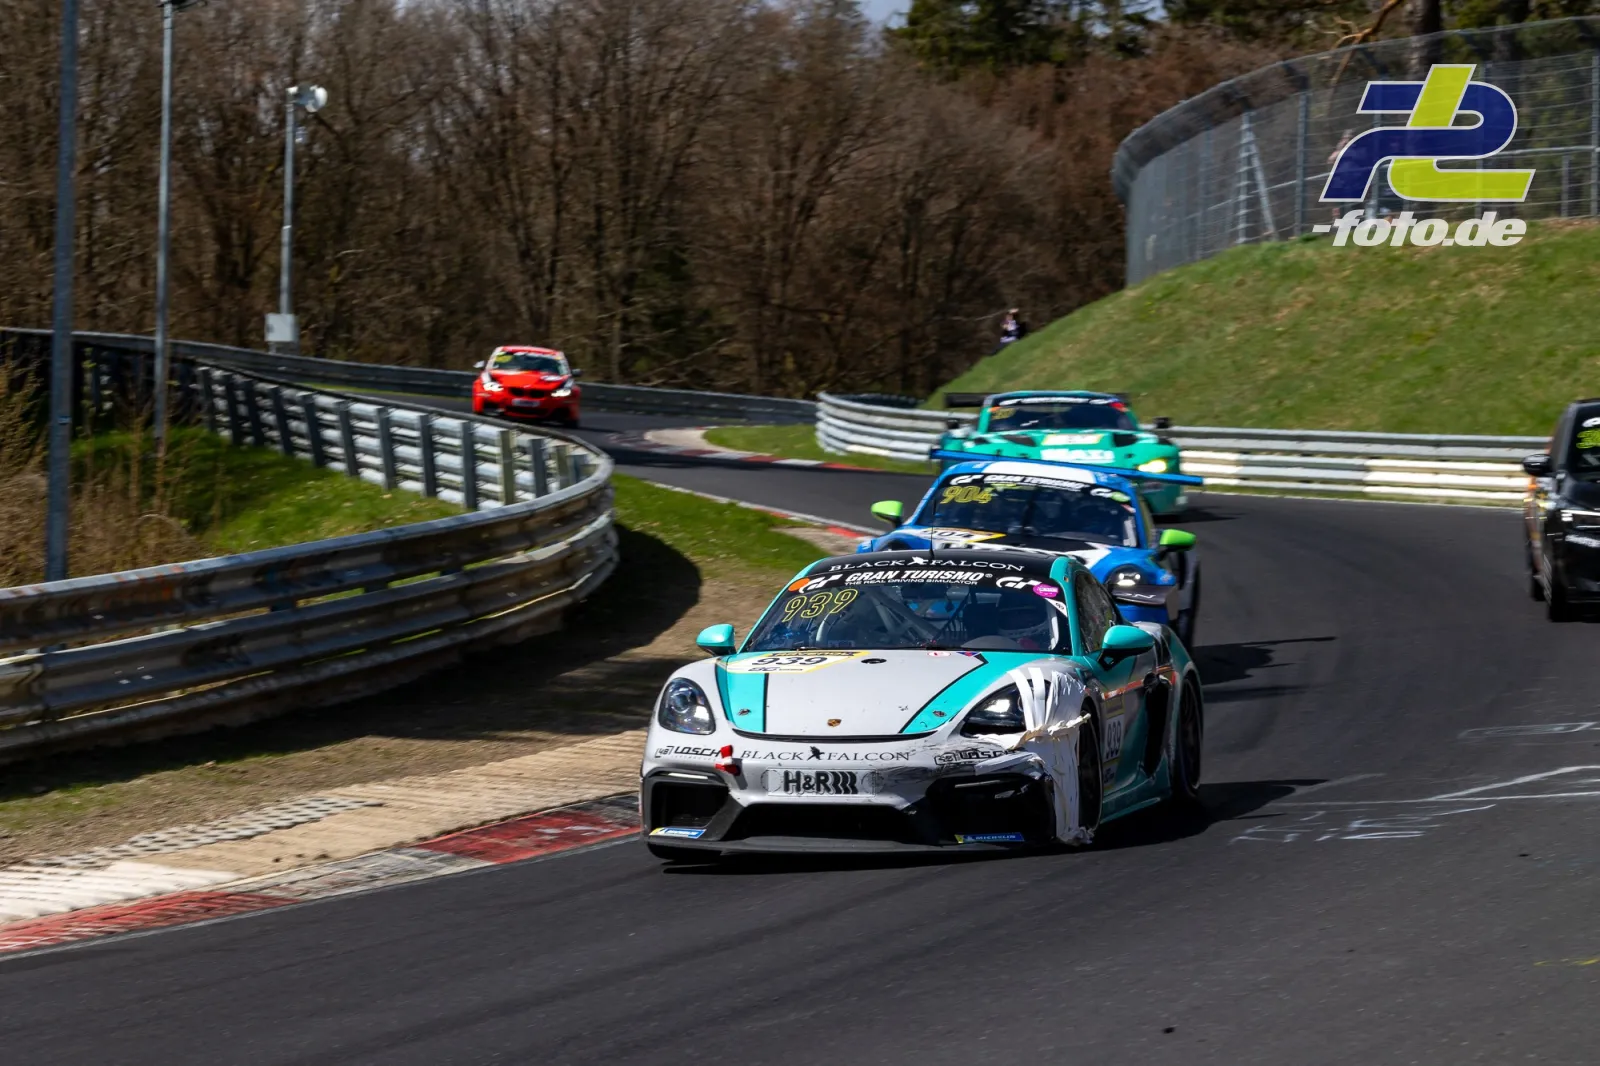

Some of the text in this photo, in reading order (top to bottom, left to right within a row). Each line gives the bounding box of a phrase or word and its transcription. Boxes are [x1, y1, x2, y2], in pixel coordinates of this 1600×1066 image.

[940, 485, 994, 504] 904
[829, 559, 1025, 572] BLACK FALCON
[845, 570, 900, 582] GRAN
[926, 578, 978, 586] SIMULATOR
[781, 588, 859, 623] 939
[752, 656, 828, 666] 939
[741, 750, 910, 761] BLACK FALCON
